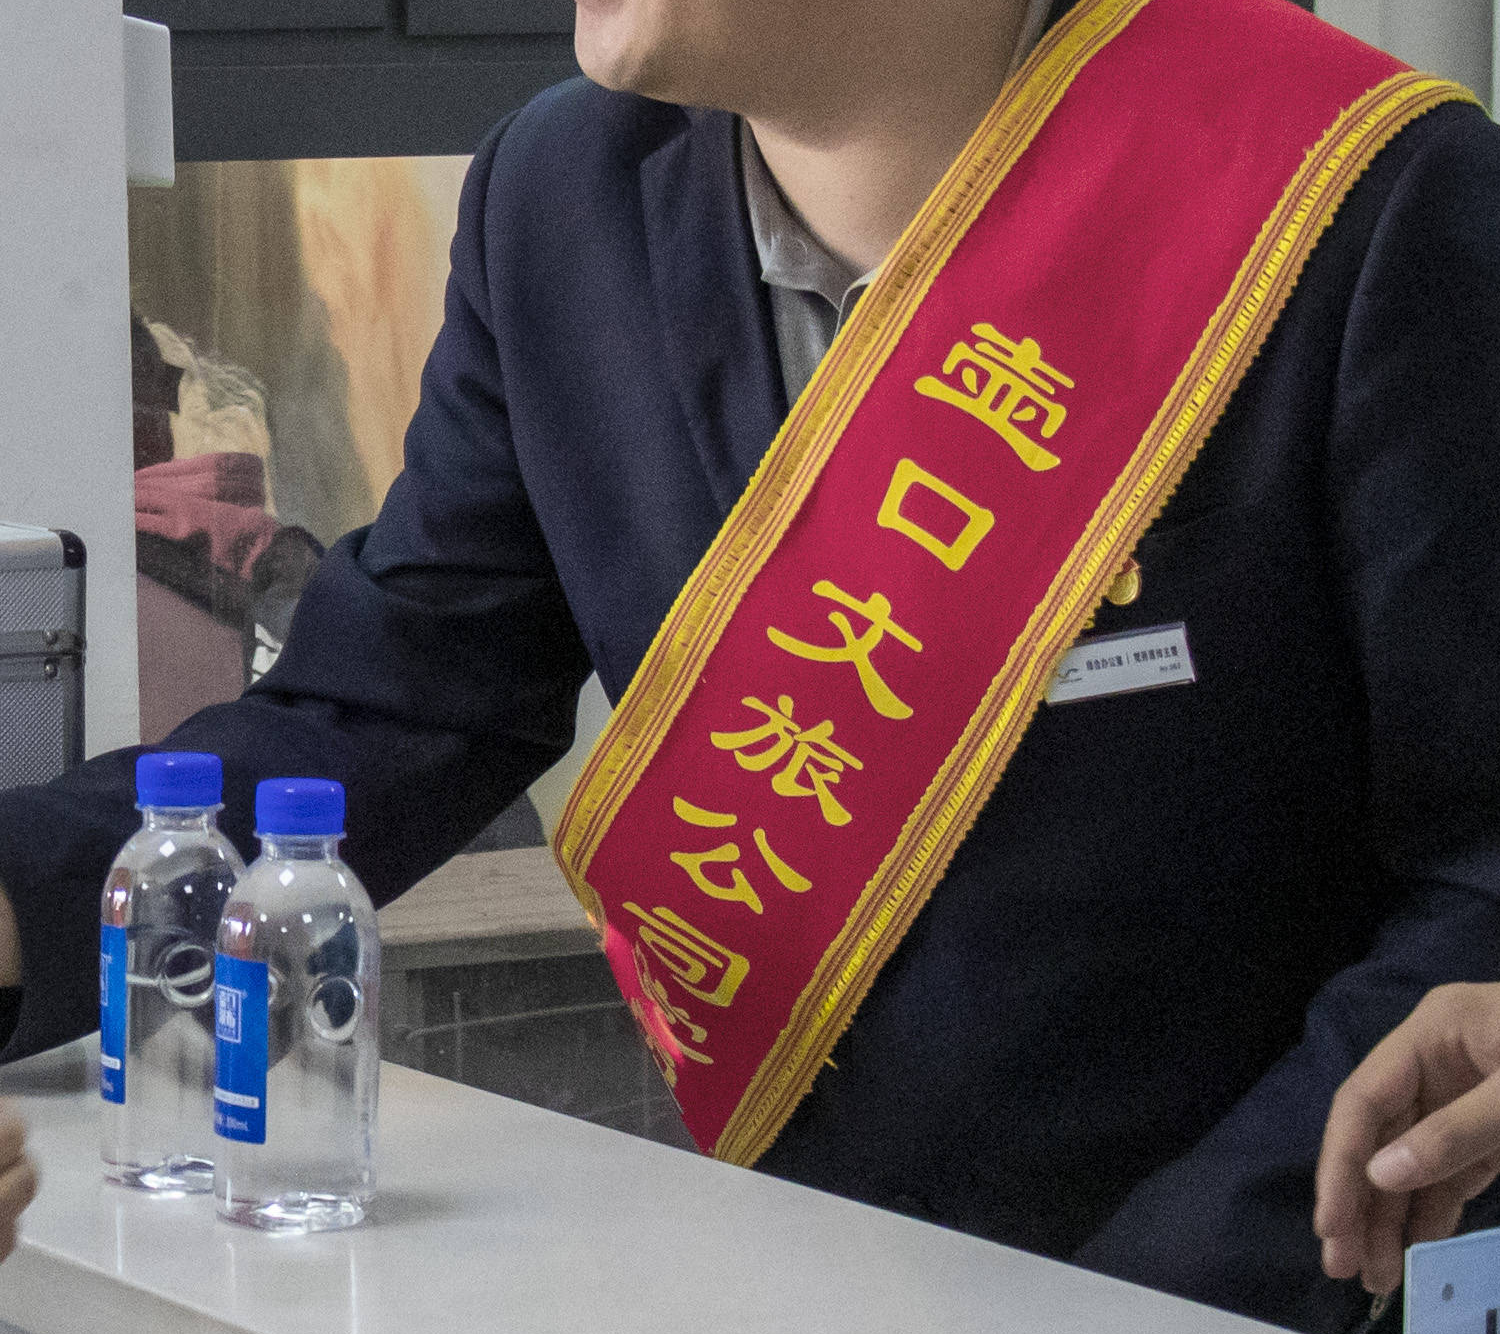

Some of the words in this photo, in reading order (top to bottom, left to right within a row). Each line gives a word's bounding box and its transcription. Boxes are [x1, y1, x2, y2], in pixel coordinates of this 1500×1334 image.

[622, 321, 1077, 1008] 壶口文旅公司
